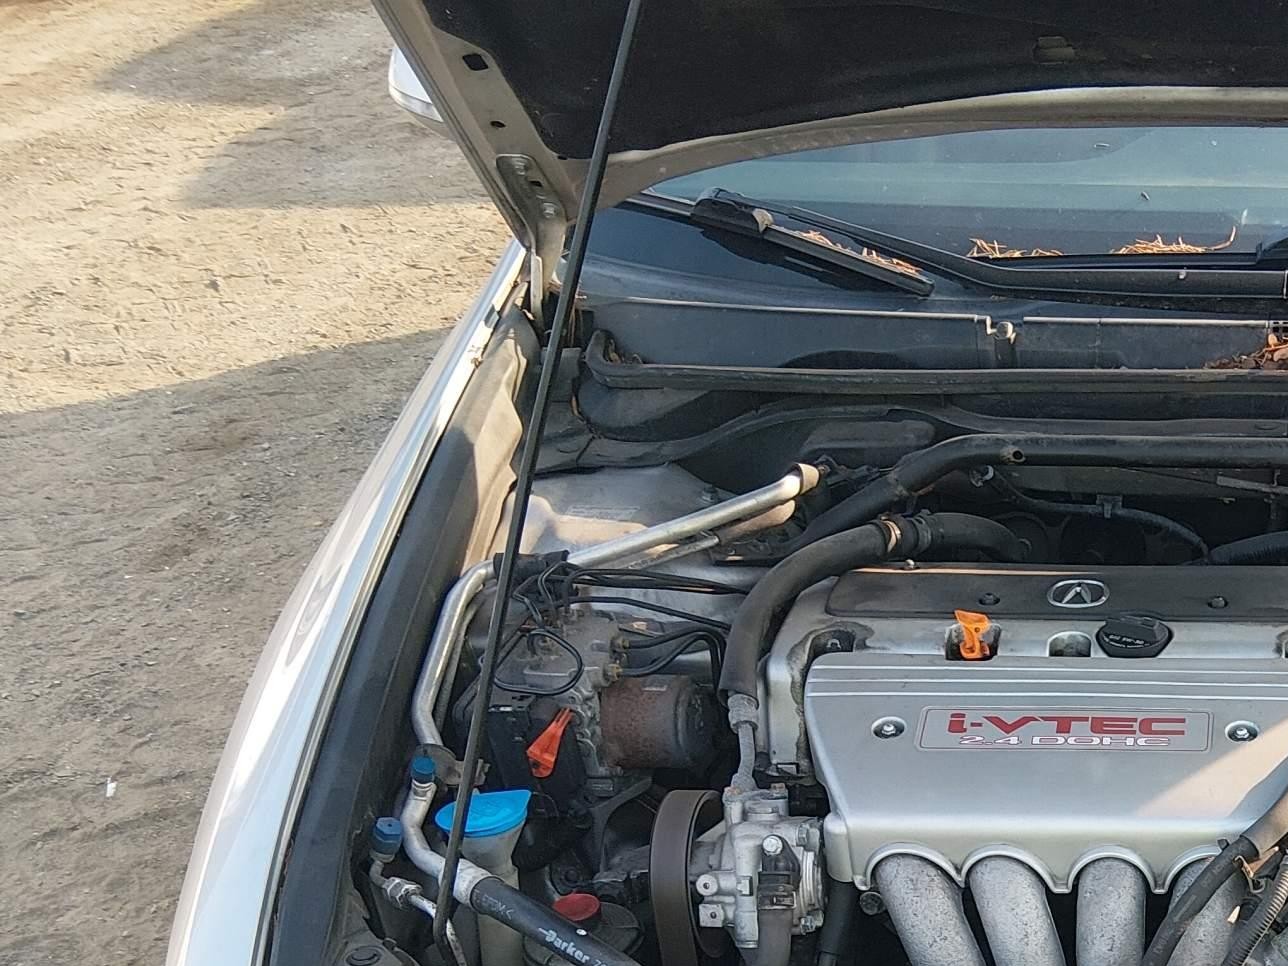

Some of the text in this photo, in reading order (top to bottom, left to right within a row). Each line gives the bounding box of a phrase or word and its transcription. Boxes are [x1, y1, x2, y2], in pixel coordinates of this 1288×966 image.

[947, 712, 1186, 736] i-VTEC
[958, 735, 1170, 747] 2.4 DOHC
[538, 927, 591, 964] Parker
